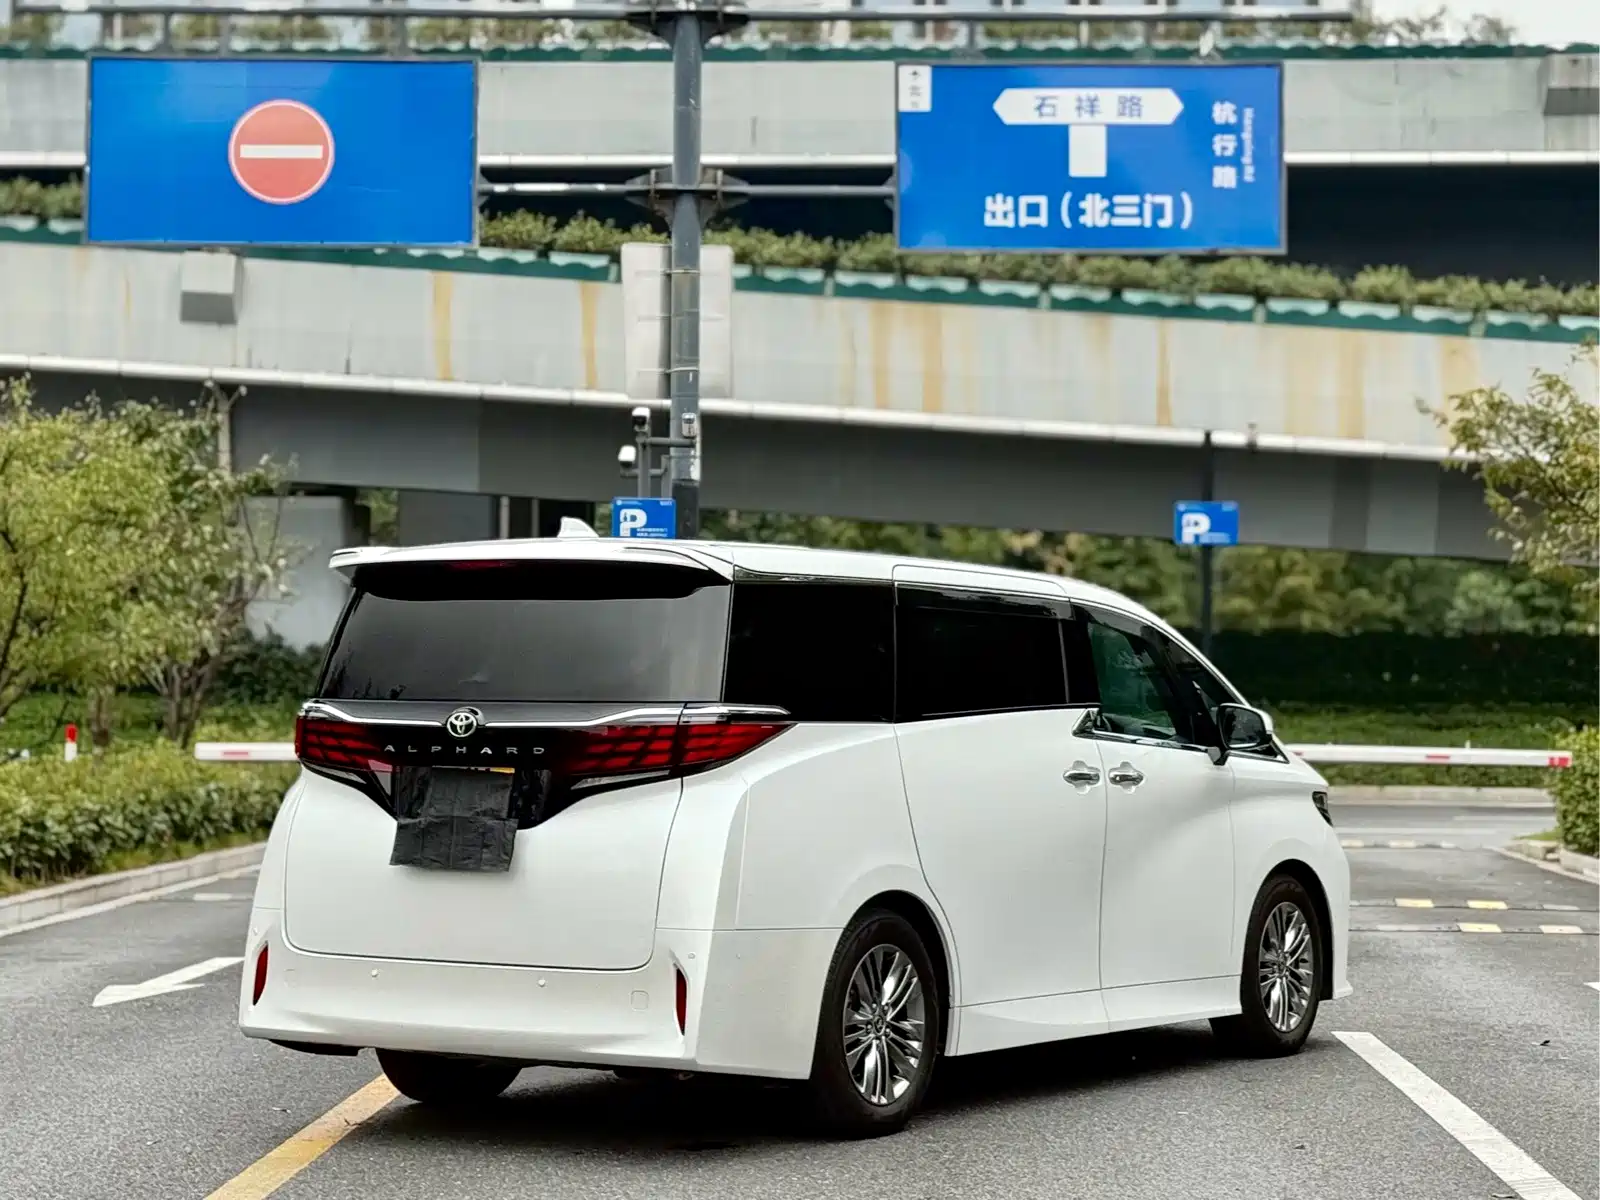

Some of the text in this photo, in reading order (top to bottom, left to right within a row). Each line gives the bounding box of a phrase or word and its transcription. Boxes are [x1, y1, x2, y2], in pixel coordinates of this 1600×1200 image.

[1034, 93, 1144, 118] 石祥路
[1211, 100, 1238, 189] 杭行路
[619, 508, 647, 537] P
[1181, 512, 1211, 544] P
[384, 744, 545, 755] ALPHARD
